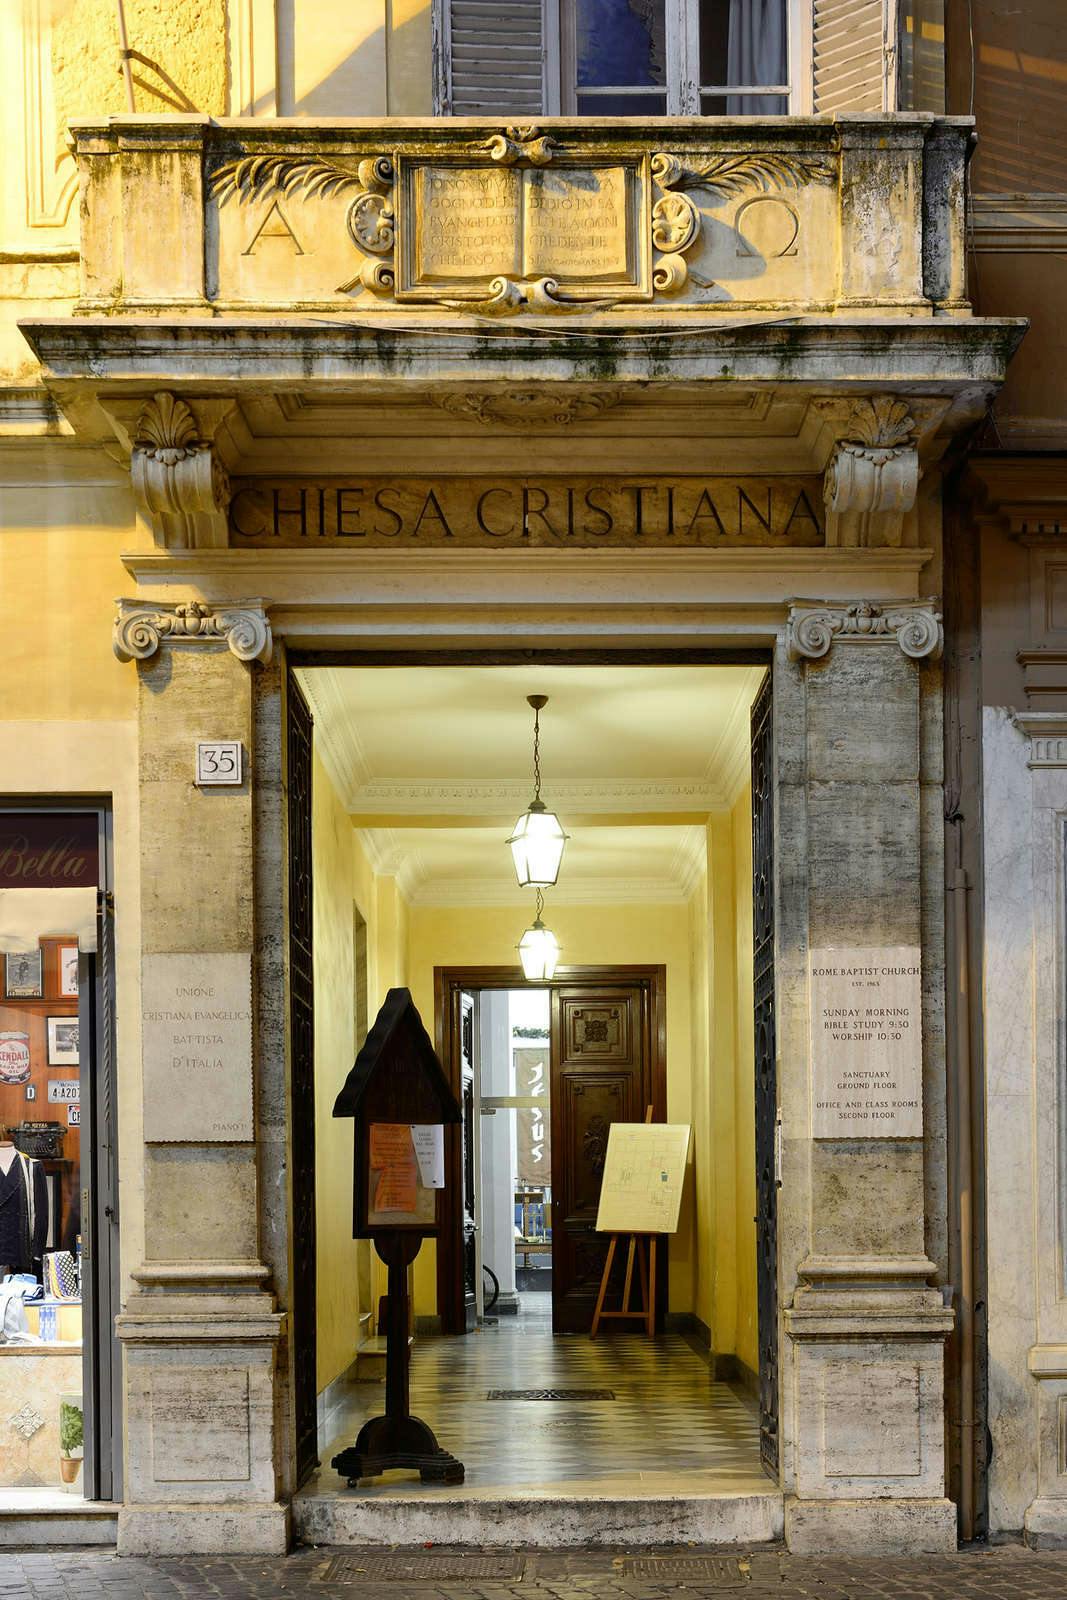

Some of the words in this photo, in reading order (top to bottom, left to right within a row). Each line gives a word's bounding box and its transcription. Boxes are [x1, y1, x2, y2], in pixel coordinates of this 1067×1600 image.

[431, 235, 484, 248] CRISTO
[230, 487, 455, 537] CHIESA
[476, 486, 825, 537] CRISTIANA
[203, 750, 235, 773] 35
[0, 833, 87, 877] Bella
[812, 967, 837, 977] ROME
[840, 967, 879, 977] BAPTIST
[881, 967, 920, 976] CHURCH
[175, 987, 216, 998] UNIONE
[143, 1011, 193, 1022] CRISTIANA
[194, 1011, 251, 1021] EVANGELICA
[823, 1008, 860, 1017] SUNDAY
[865, 1008, 910, 1017] MORNING
[824, 1021, 849, 1030] BIBLE
[853, 1021, 884, 1029] STUDY
[173, 1035, 224, 1045] BATTISTA
[832, 1033, 873, 1041] WORSHIP
[877, 1032, 902, 1041] 10:30
[843, 1071, 890, 1079] SANCTUARY
[837, 1082, 870, 1090] GROUND
[873, 1082, 897, 1090] FLOOR
[27, 1087, 35, 1099] D
[816, 1101, 841, 1109] OFFICE
[845, 1101, 862, 1109] AND
[865, 1101, 889, 1109] CLASS
[892, 1101, 919, 1109] ROOMS
[838, 1112, 869, 1120] SECOND
[872, 1112, 896, 1120] FLOOR
[212, 1122, 240, 1131] PIANO
